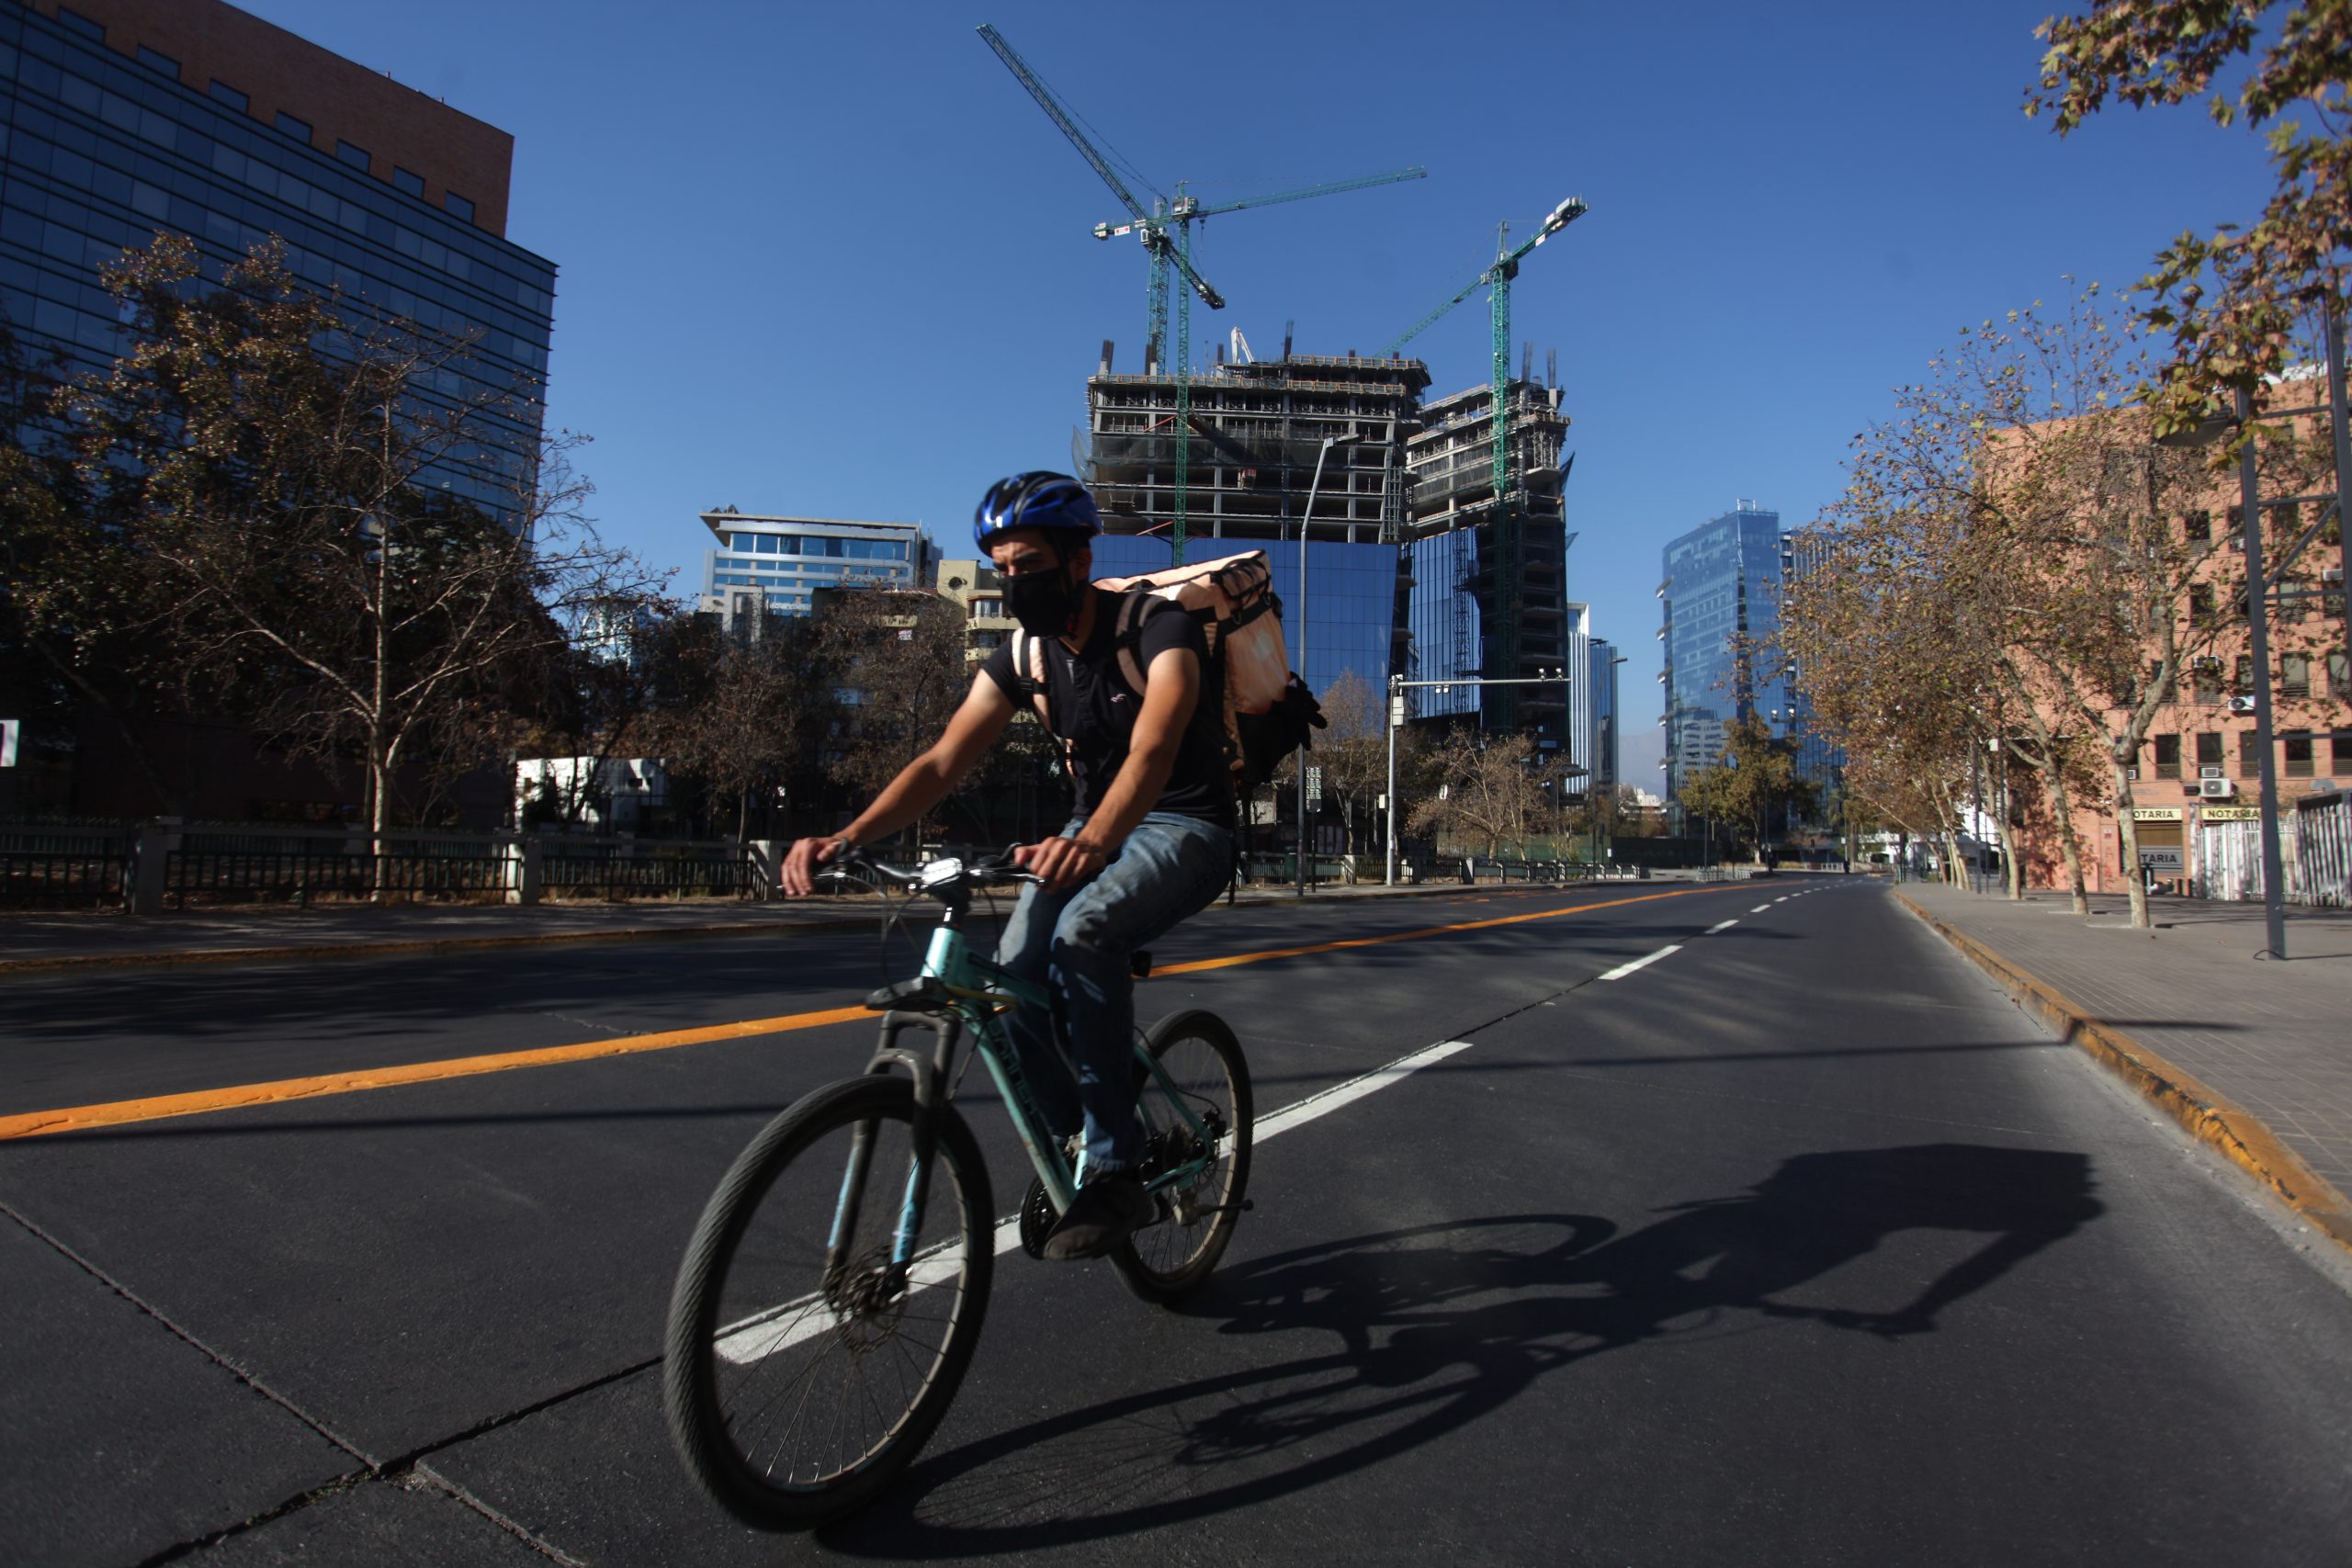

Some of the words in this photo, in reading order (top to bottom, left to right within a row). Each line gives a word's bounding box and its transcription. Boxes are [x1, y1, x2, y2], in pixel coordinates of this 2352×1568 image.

[2132, 810, 2174, 818] OTARIA
[2208, 809, 2260, 818] NOTARIA
[2140, 853, 2177, 863] TARIA
